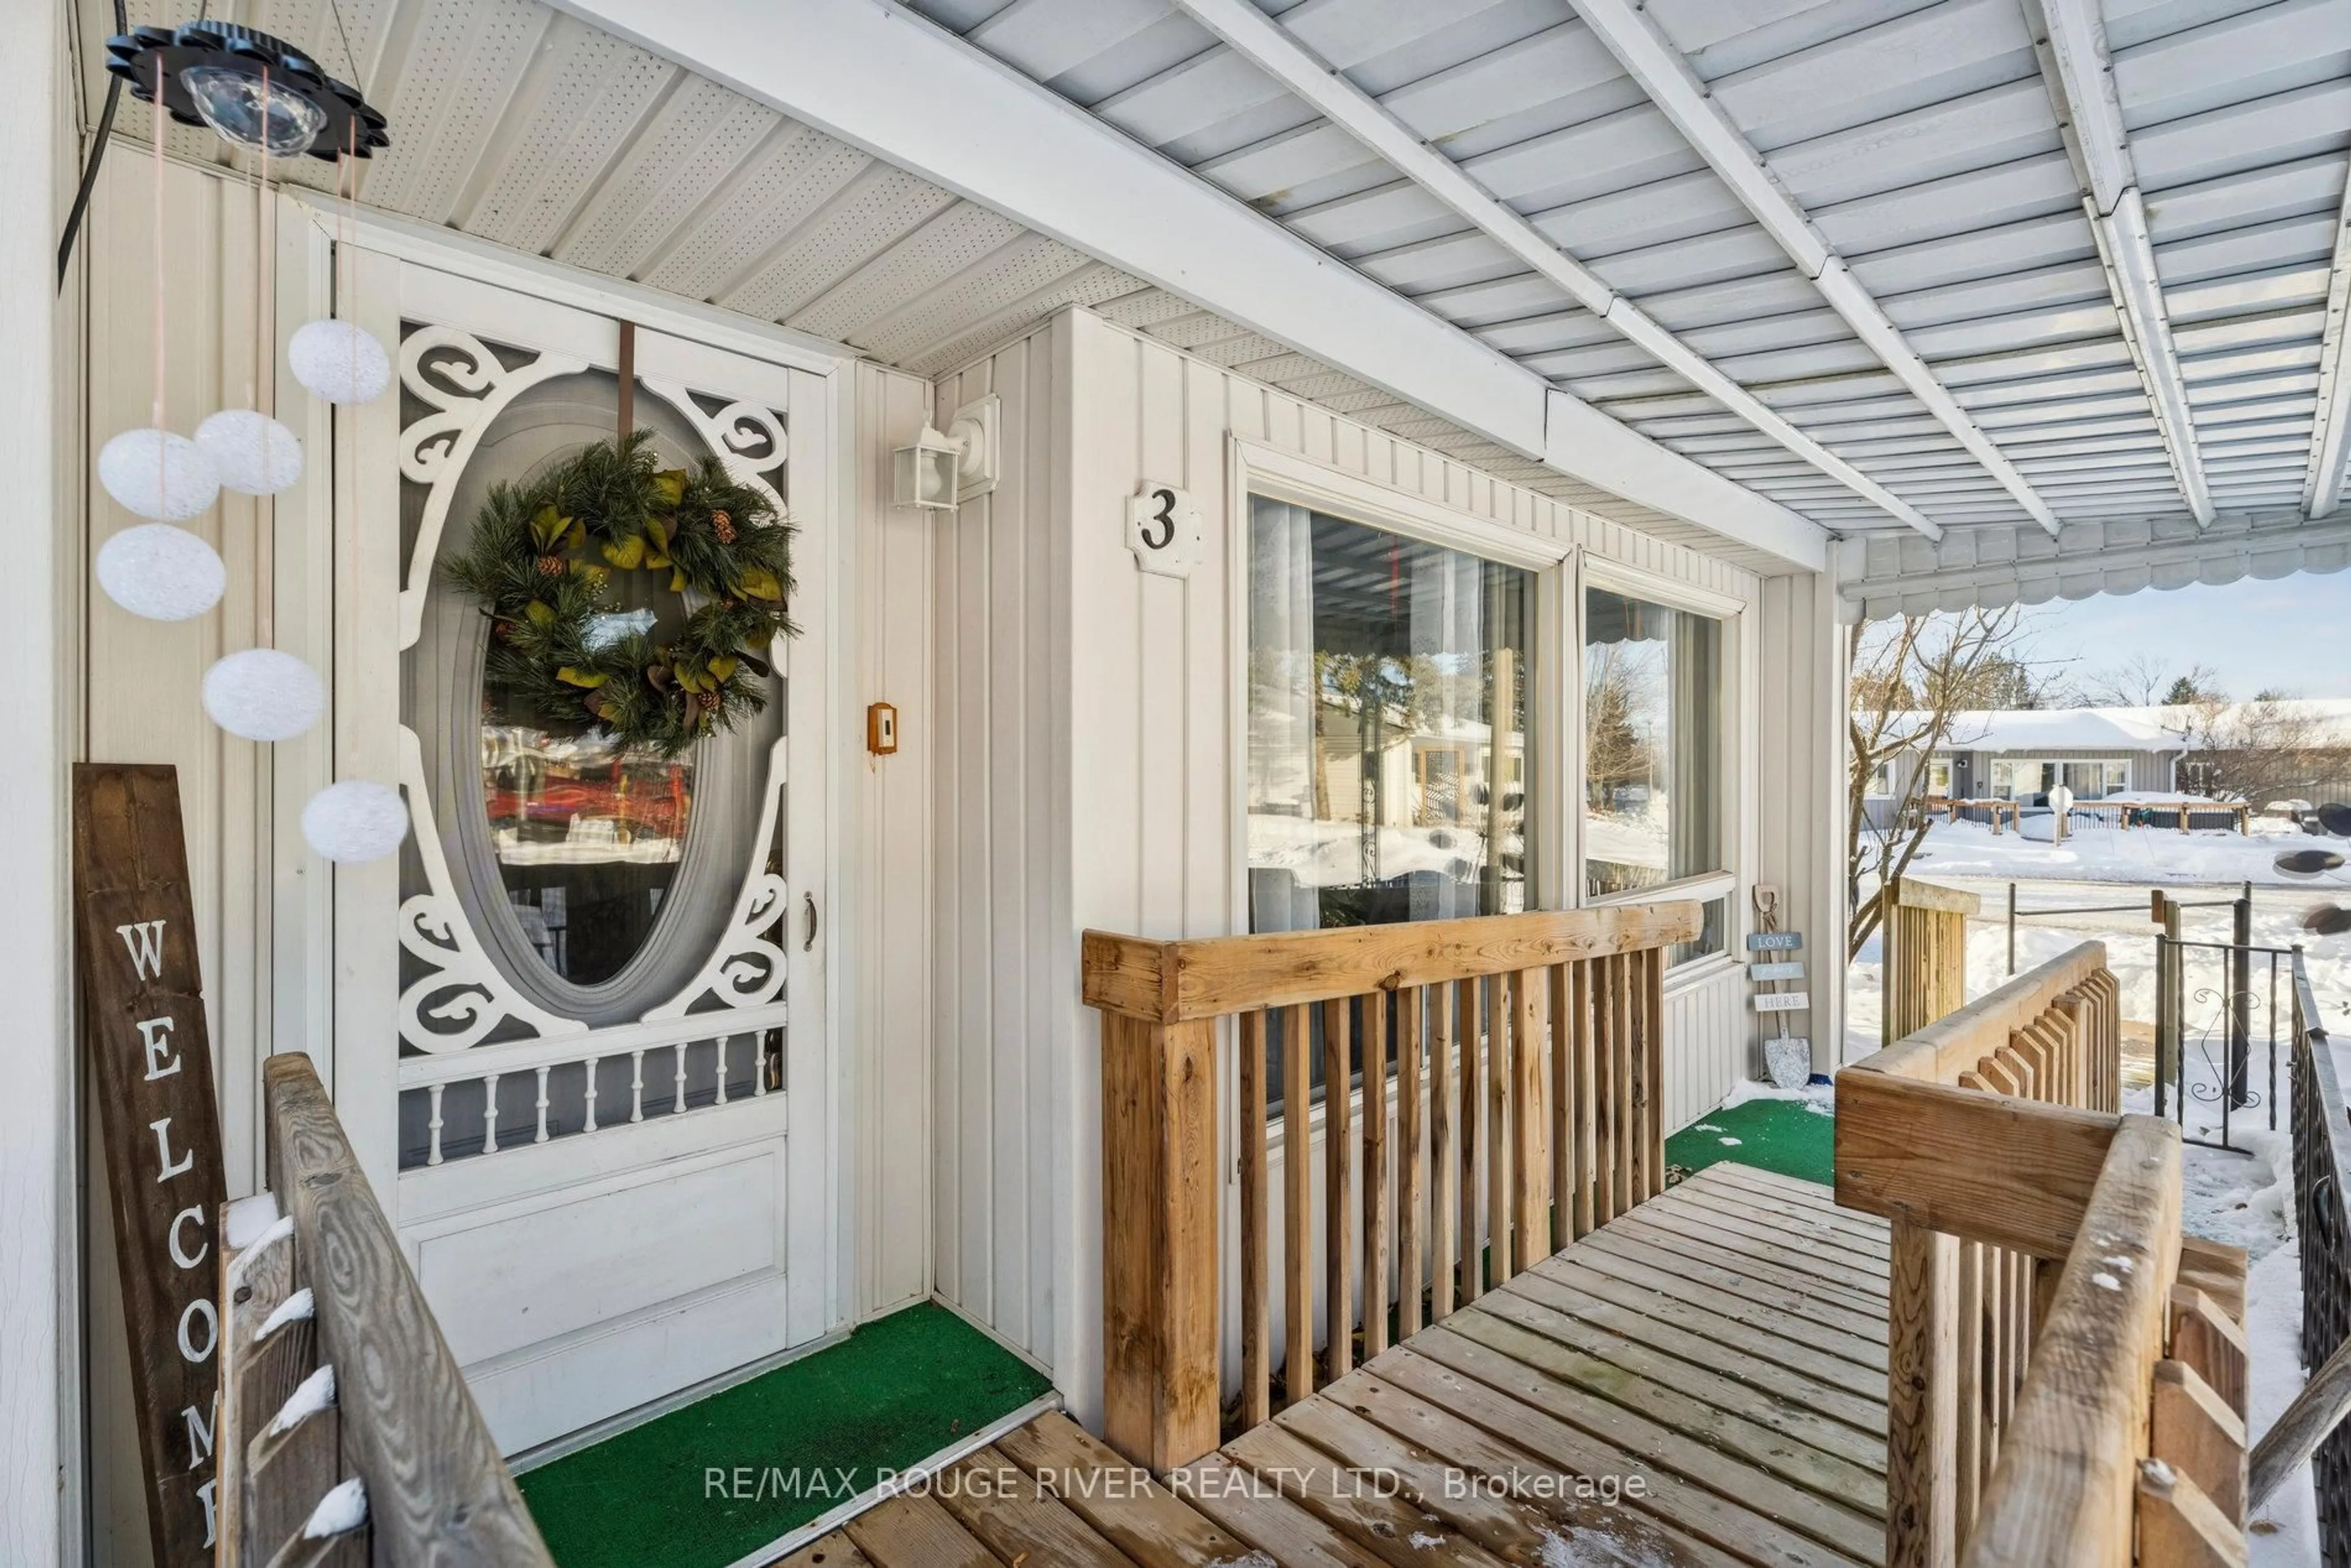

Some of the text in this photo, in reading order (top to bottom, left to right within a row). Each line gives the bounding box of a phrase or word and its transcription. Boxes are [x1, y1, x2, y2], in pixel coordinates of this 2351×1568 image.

[1141, 489, 1176, 550] 3
[1758, 936, 1793, 948] LOVE
[1764, 995, 1800, 1008] HERE
